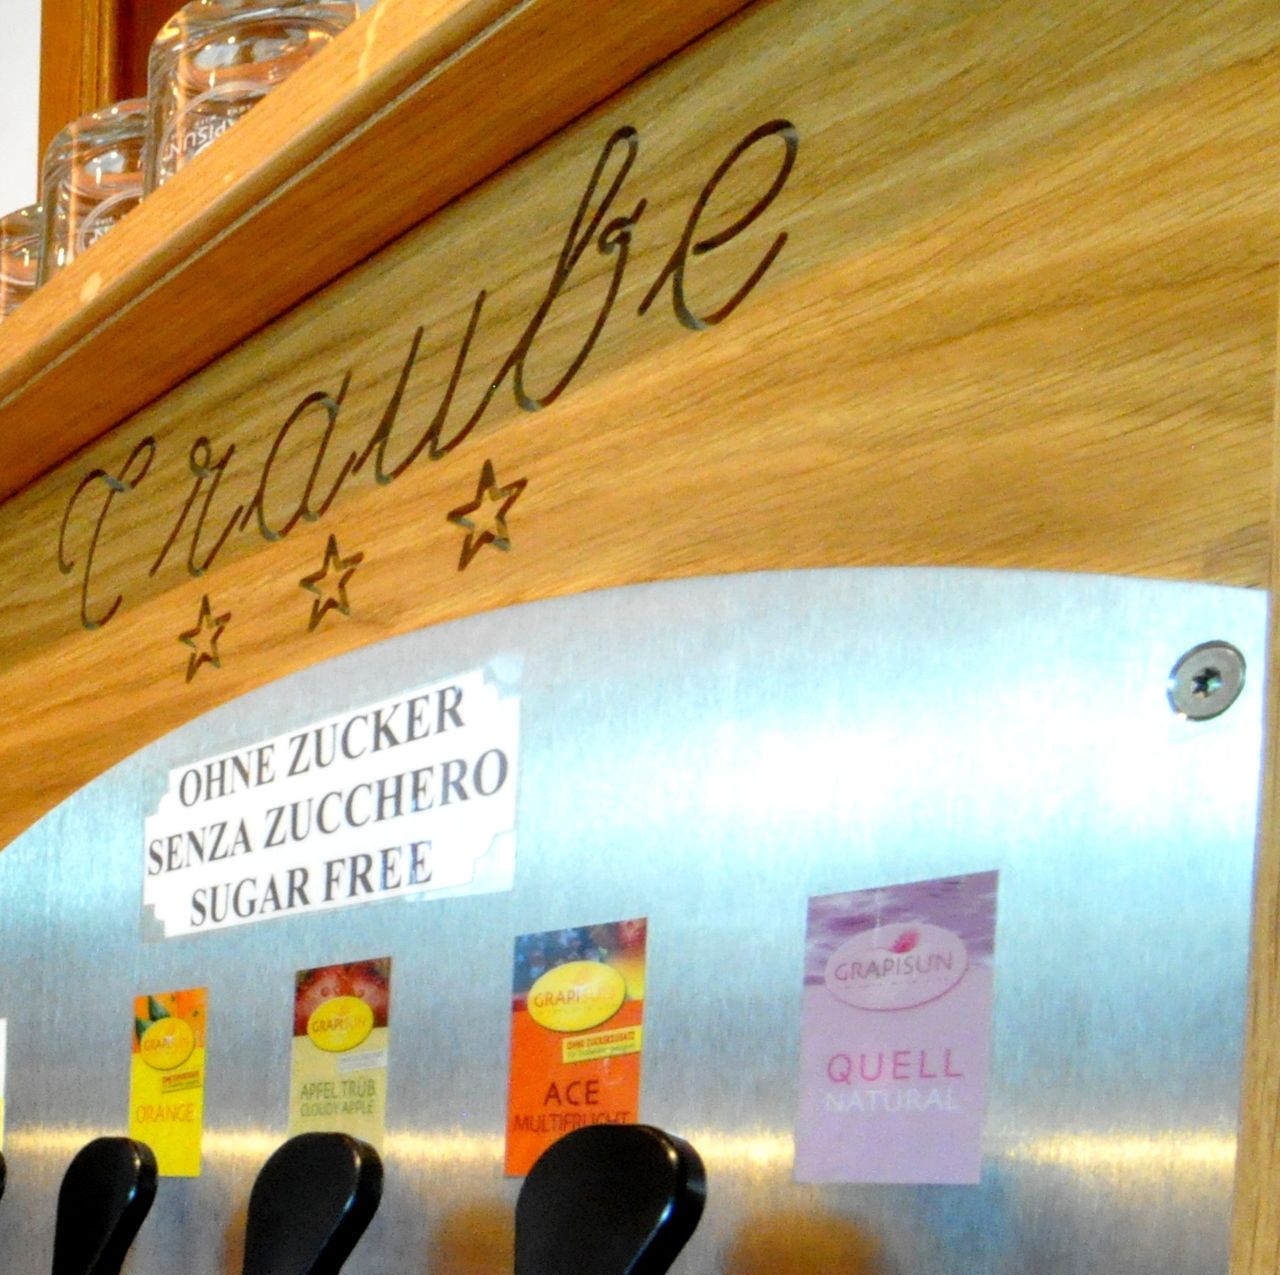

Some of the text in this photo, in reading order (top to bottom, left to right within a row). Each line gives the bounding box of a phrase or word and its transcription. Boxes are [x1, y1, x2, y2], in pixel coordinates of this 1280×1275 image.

[178, 685, 466, 808] OHNE ZUCKER
[147, 747, 509, 876] SENZA ZUCCHERO
[190, 839, 434, 927] SUGAR FREE
[834, 952, 954, 982] GRAPISUN
[827, 1049, 964, 1086] QUELL
[300, 1081, 338, 1100] APFEL
[543, 1079, 601, 1107] ACE
[825, 1087, 960, 1113] NATURAL
[136, 1103, 195, 1124] ORANGE
